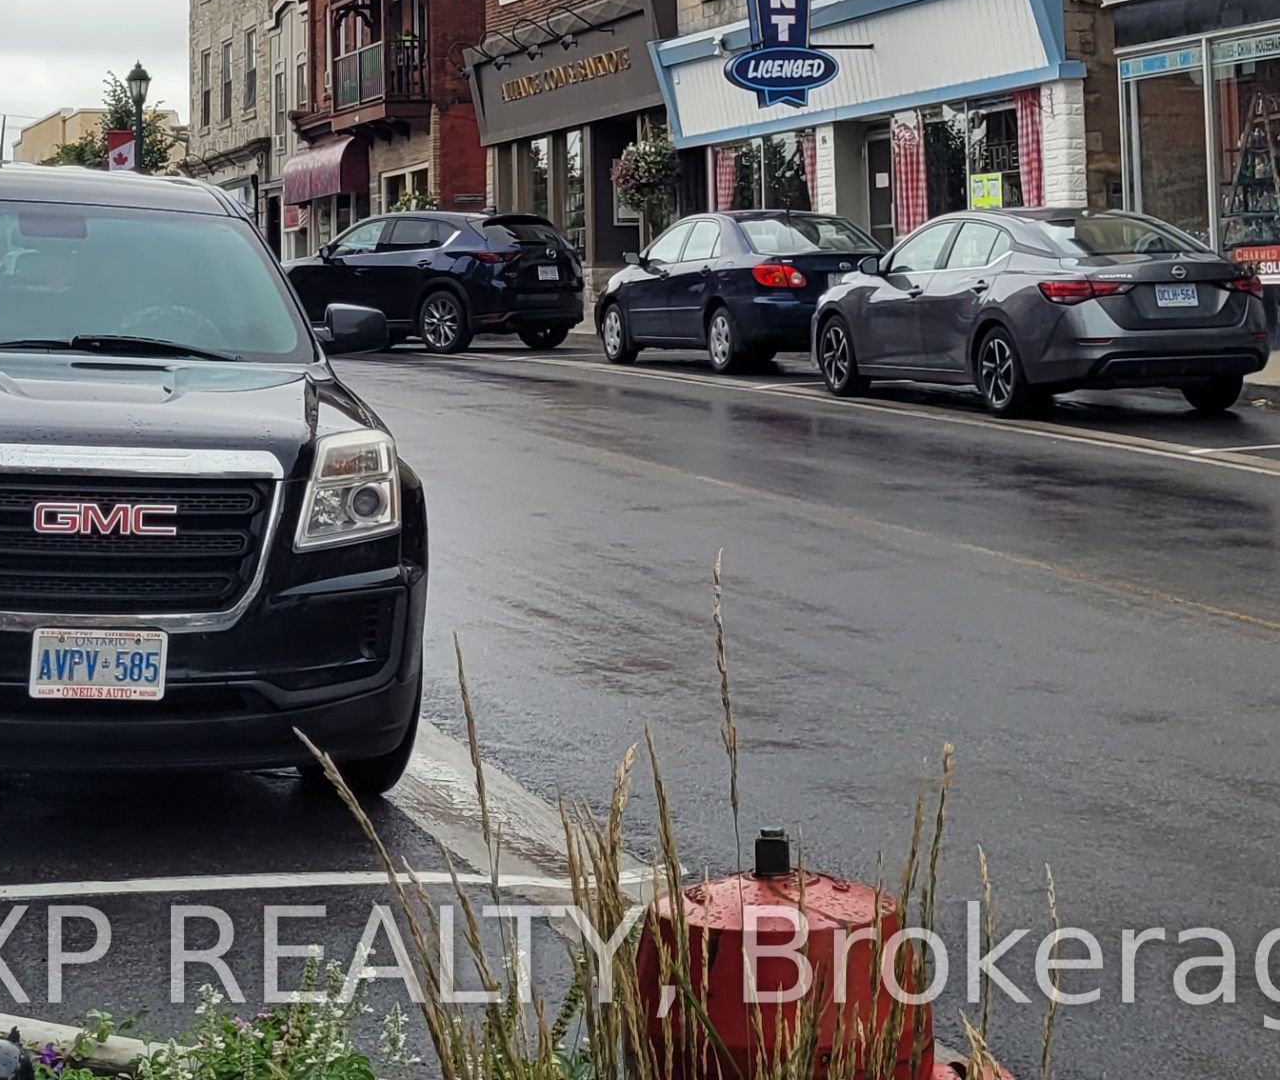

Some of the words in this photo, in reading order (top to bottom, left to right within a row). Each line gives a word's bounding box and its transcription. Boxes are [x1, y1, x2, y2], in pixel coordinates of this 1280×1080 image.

[747, 58, 825, 79] LICENSED
[1235, 249, 1276, 262] CHARMED
[33, 502, 178, 536] GMC
[75, 637, 127, 647] ONTARIO
[39, 648, 100, 681] AVPV
[114, 649, 160, 683] 585
[62, 687, 103, 698] O'NEIL'S
[105, 688, 132, 699] AUTO
